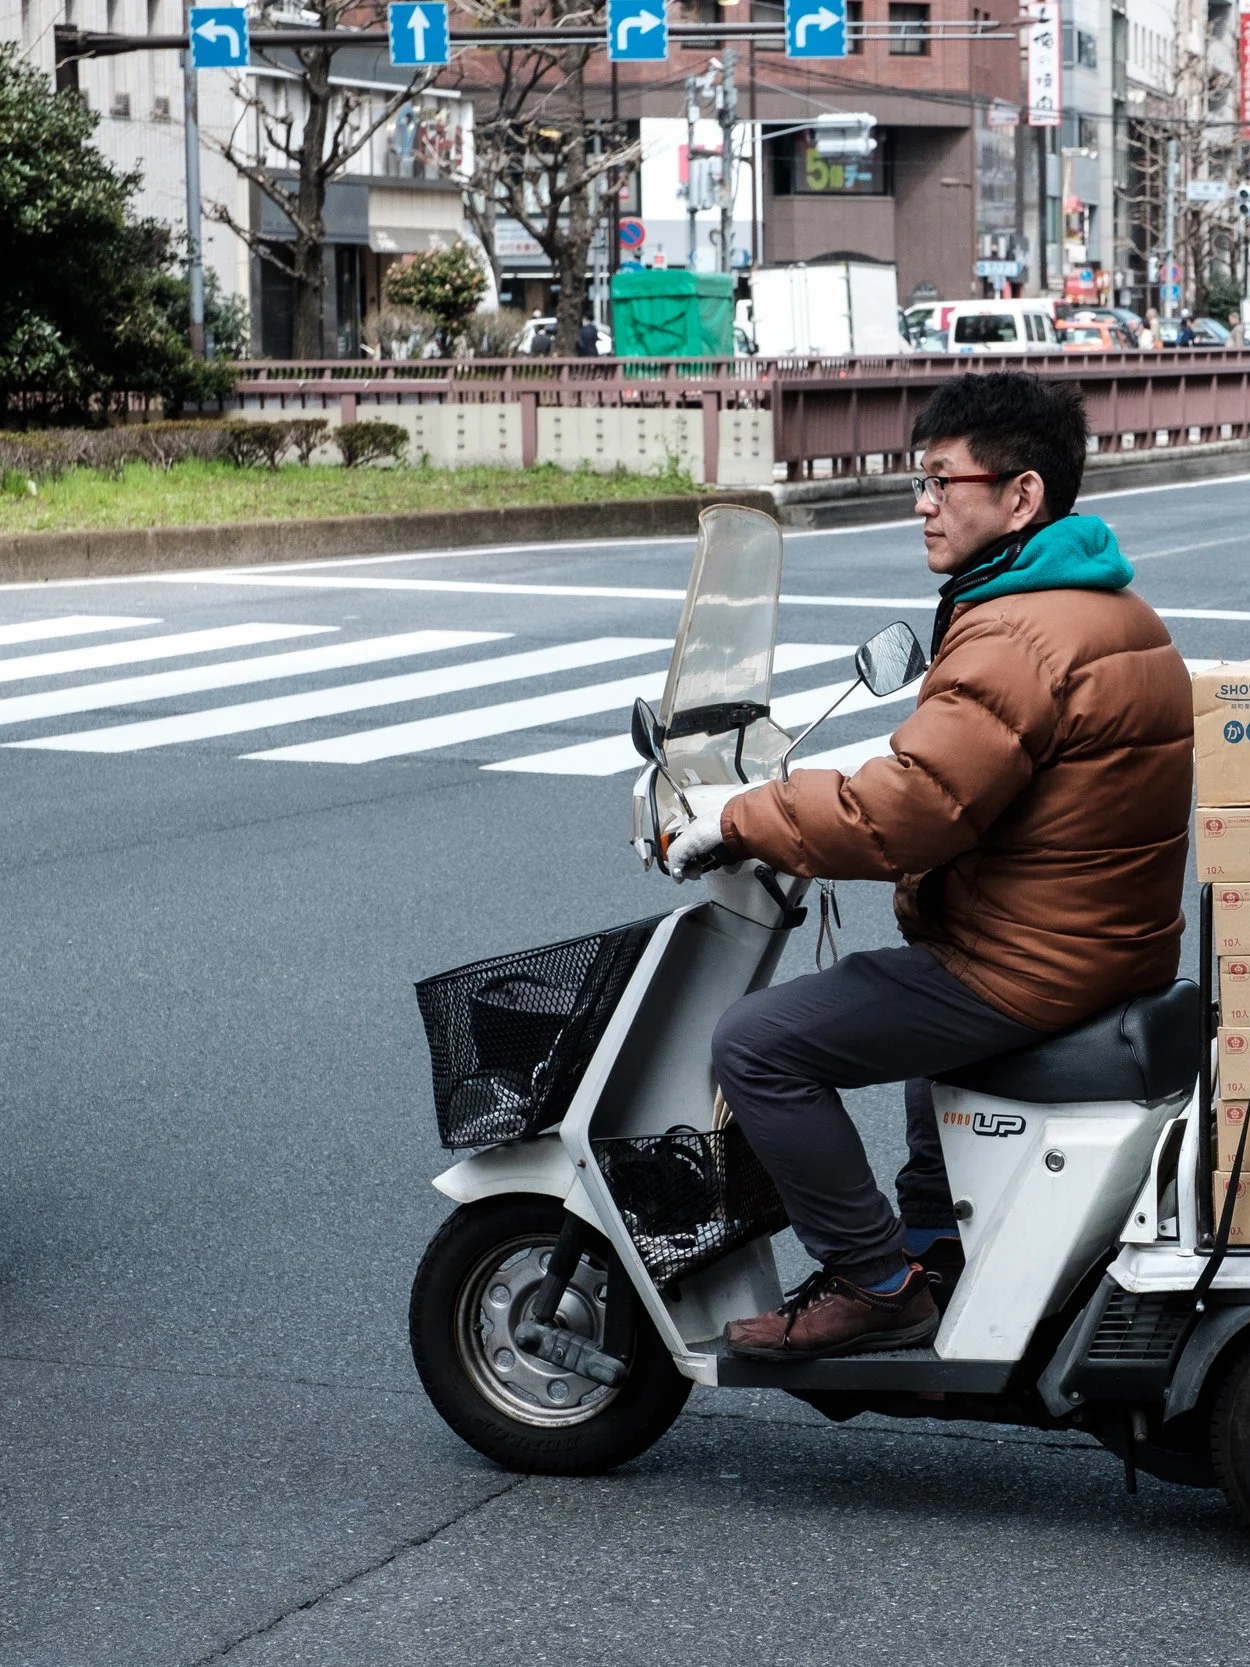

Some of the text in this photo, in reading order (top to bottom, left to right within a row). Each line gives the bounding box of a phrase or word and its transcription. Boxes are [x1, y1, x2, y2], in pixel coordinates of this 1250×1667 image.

[1206, 866, 1225, 875] 10入
[1223, 938, 1242, 947] 10入
[1230, 1009, 1249, 1019] 10入
[1227, 1082, 1246, 1092] 10入
[972, 1112, 1026, 1138] UP
